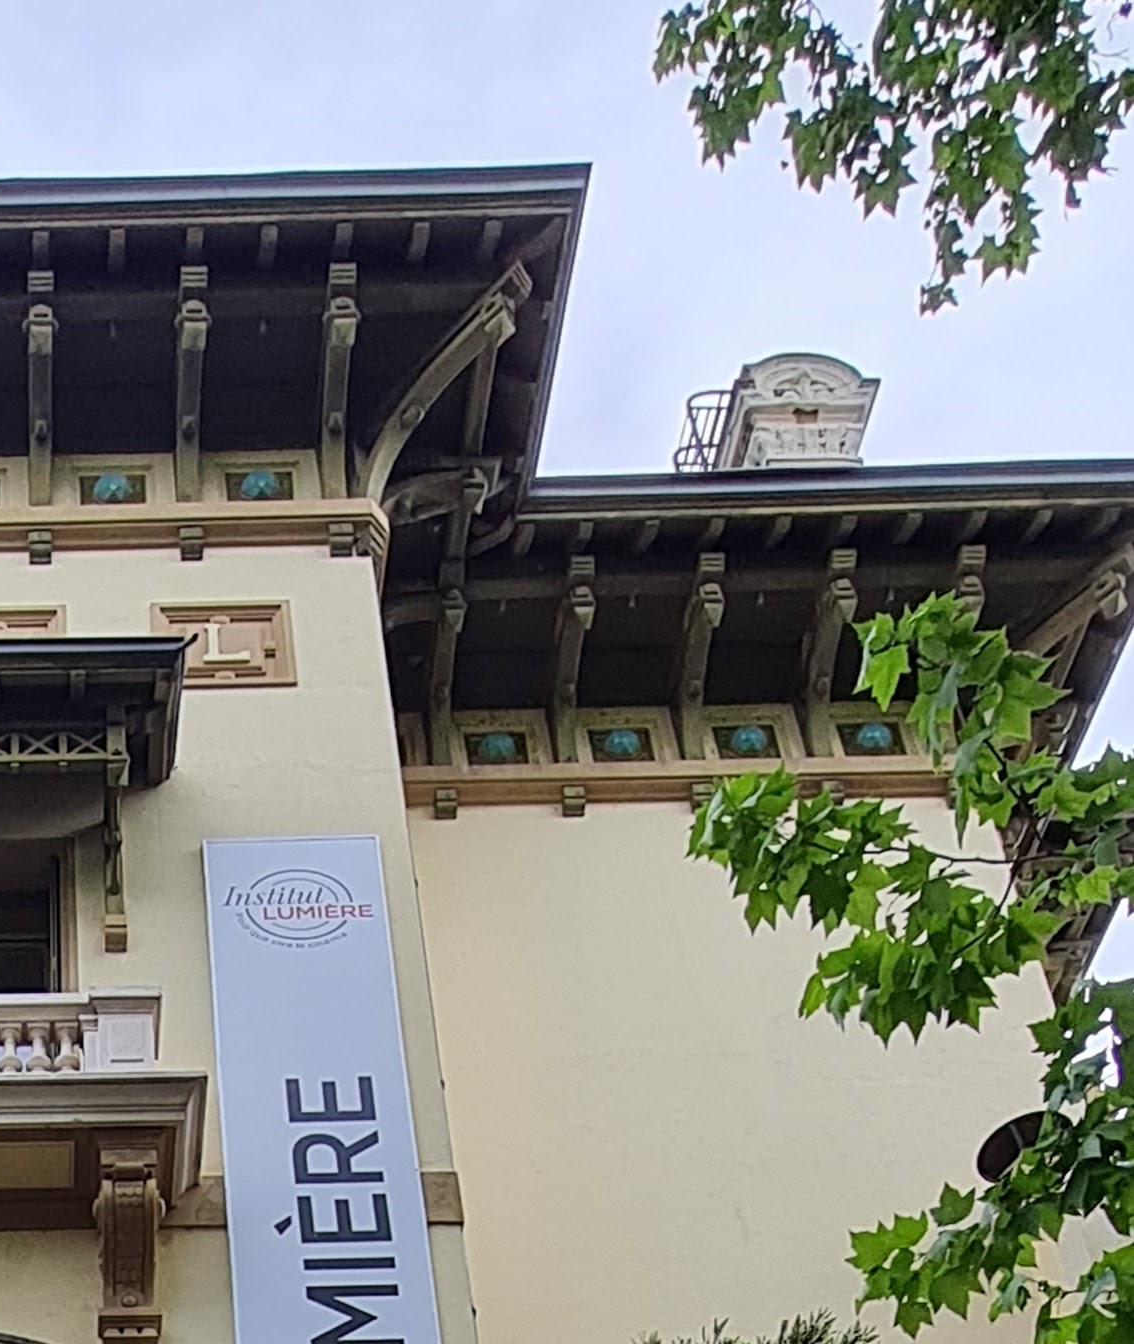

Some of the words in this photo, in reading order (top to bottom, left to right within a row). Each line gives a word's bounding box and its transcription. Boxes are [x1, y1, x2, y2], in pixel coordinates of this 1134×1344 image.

[203, 622, 251, 662] L
[223, 885, 323, 907] Institut
[263, 903, 374, 921] LUMIÈRE
